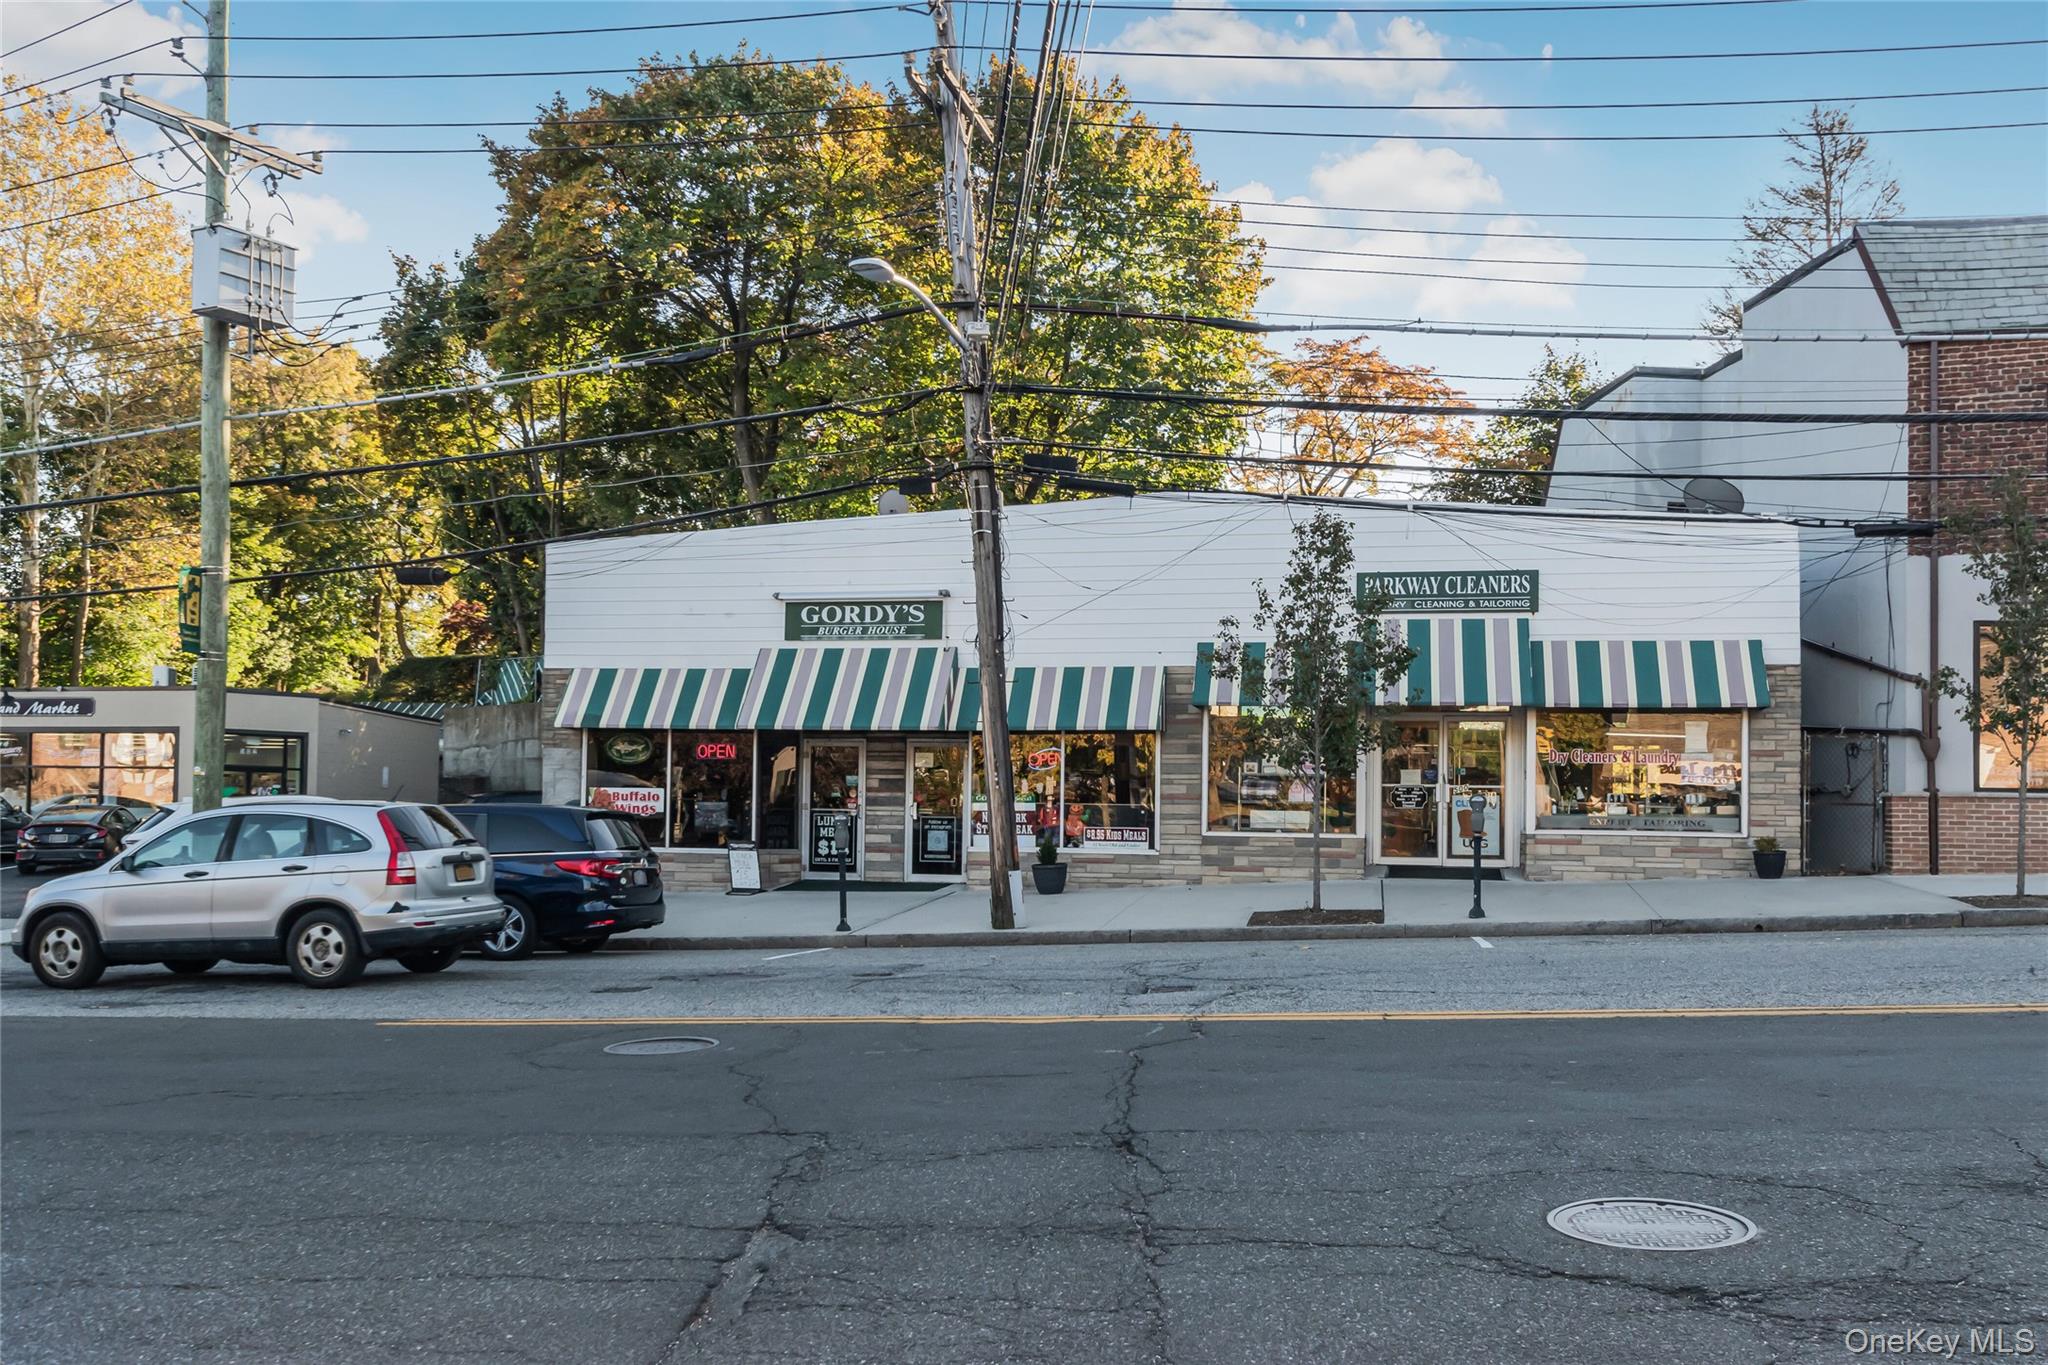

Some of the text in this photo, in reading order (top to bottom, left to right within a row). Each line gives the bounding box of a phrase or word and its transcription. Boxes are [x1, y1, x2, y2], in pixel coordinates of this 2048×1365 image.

[1445, 574, 1531, 595] CLEANERS
[1414, 600, 1465, 609] CLEANING
[1468, 600, 1476, 608] &
[1480, 599, 1531, 608] TAILORING
[800, 604, 925, 625] GORDY'S
[818, 626, 908, 636] BURGER HOUSE
[24, 701, 80, 716] Market
[697, 744, 737, 759] OPEN
[1549, 747, 1681, 767] Dry Cleaners & Laundry
[612, 791, 661, 803] Buffalo
[614, 804, 657, 816] Wings
